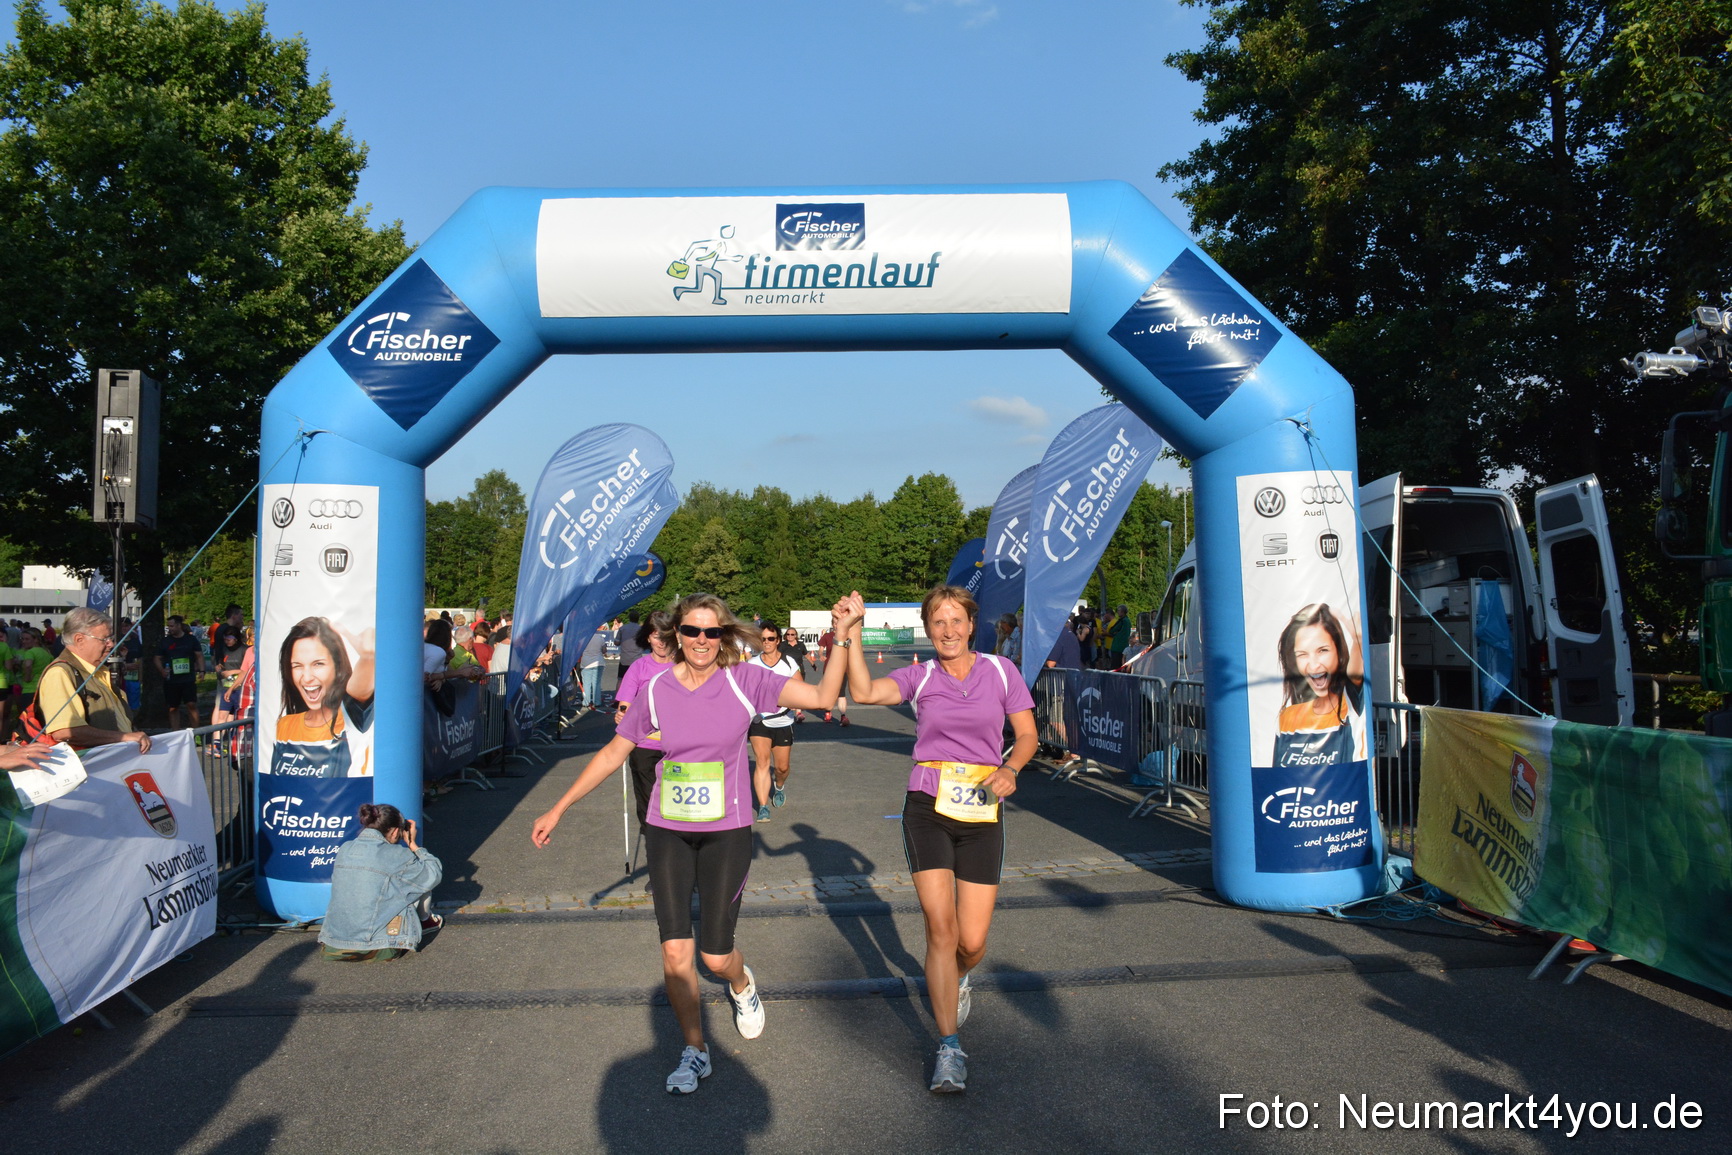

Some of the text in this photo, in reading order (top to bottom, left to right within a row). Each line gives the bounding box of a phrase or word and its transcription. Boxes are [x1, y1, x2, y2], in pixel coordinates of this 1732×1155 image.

[795, 219, 860, 232] Fischer
[744, 251, 942, 288] firmenlauf
[744, 290, 825, 304] neumarkt
[1211, 313, 1261, 326] Lächeln
[366, 329, 471, 350] Fischer
[1230, 329, 1260, 341] mit!
[374, 352, 462, 361] AUTOMOBILE
[1060, 427, 1131, 543] Fischer
[1085, 447, 1140, 540] AUTOMOBILE
[559, 447, 642, 552] Fischer
[586, 467, 650, 551] AUTOMOBILE
[1303, 509, 1325, 517] Audi
[310, 522, 332, 530] Audi
[616, 502, 661, 568] AUTOMOBILE
[1321, 539, 1338, 553] FIAT
[326, 552, 347, 568] FIAT
[1256, 559, 1297, 567] SEAT
[444, 716, 475, 746] Fischer
[1083, 708, 1124, 738] Fischer
[672, 785, 710, 805] 328
[950, 786, 987, 806] 329
[1280, 800, 1358, 819] Fischer
[273, 811, 352, 829] Fischer
[1288, 816, 1355, 828] AUTOMOBILE
[278, 829, 345, 838] AUTOMOBILE
[1324, 832, 1341, 843] das
[308, 845, 325, 855] das
[145, 843, 208, 886] Neumarkter
